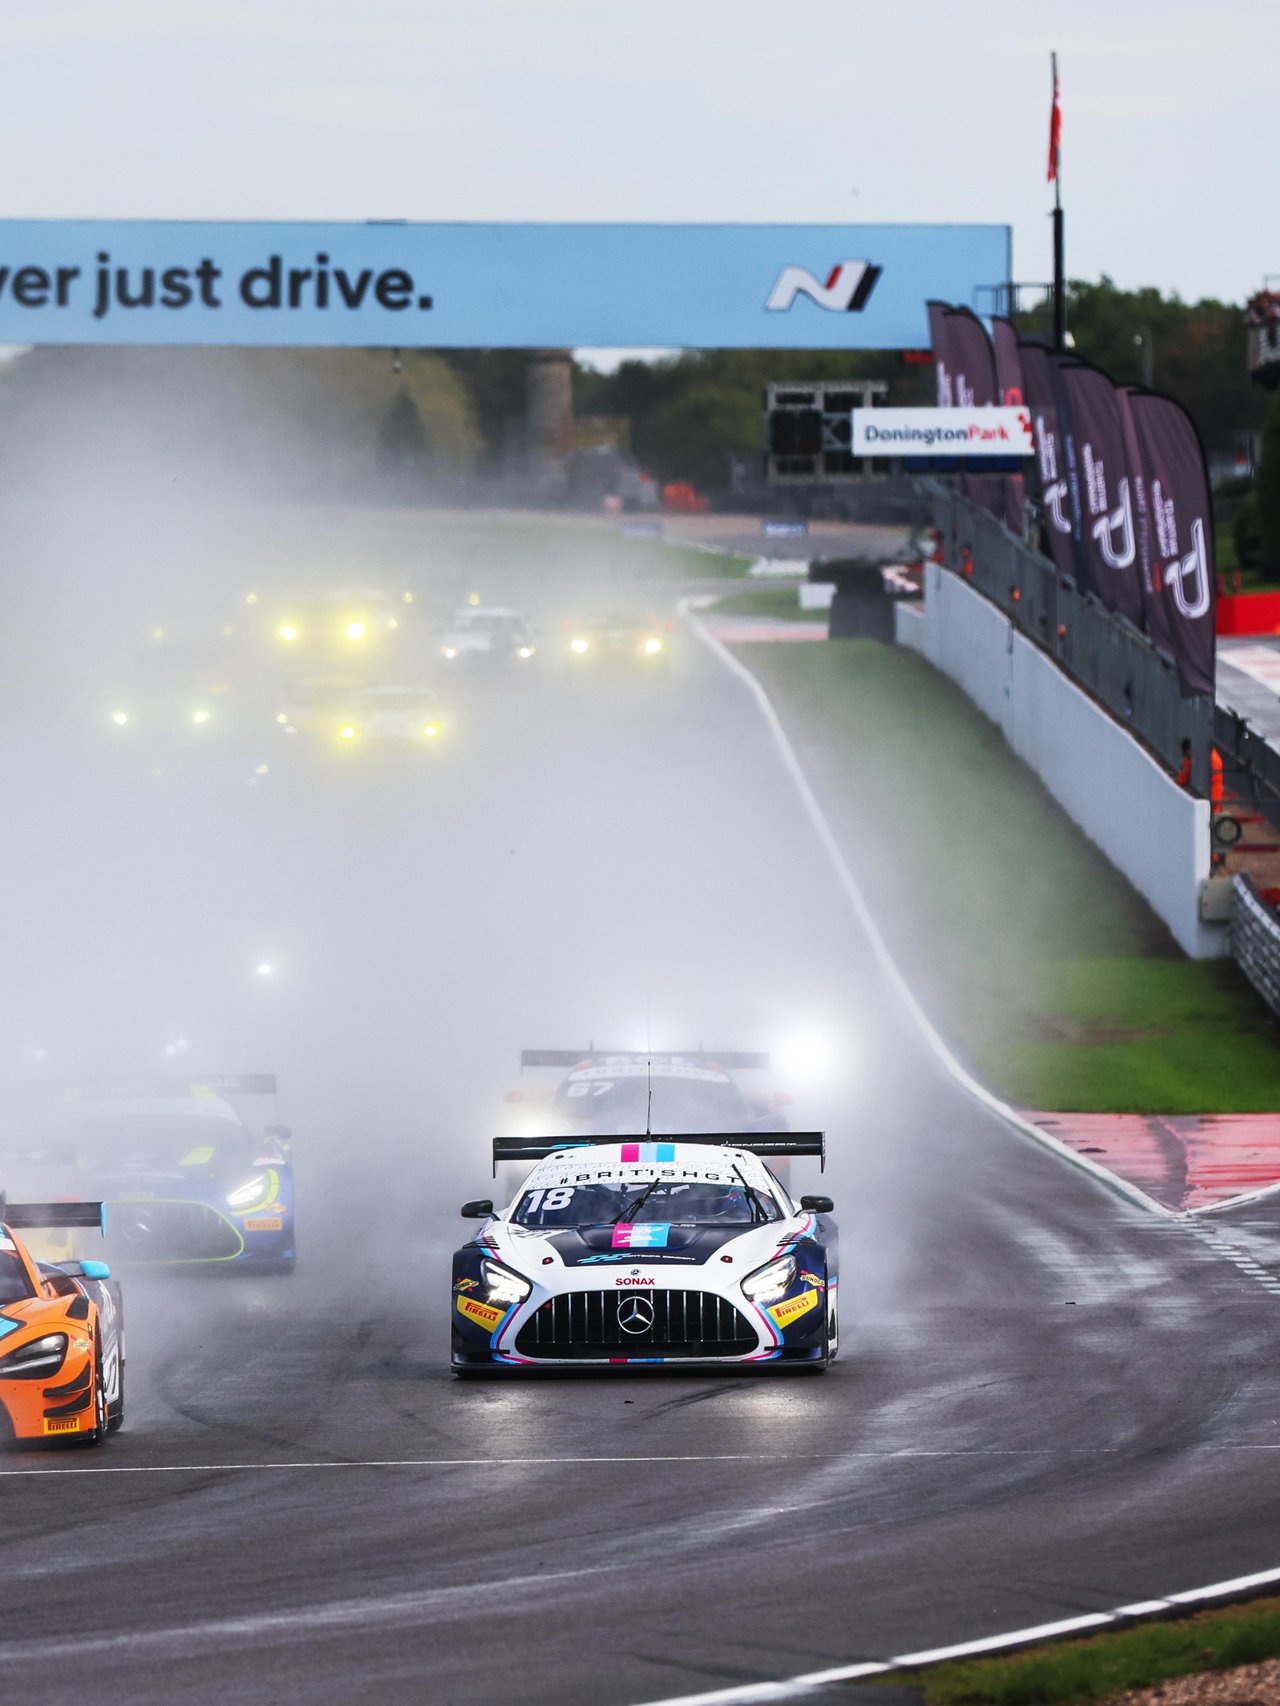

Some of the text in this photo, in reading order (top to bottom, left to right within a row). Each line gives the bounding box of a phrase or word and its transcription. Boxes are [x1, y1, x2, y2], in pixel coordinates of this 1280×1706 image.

[93, 252, 221, 319] just
[238, 255, 433, 310] drive.
[864, 424, 1009, 445] DoningtonPark
[567, 1081, 616, 1097] 67
[560, 1168, 740, 1185] #BRITISHGT
[526, 1188, 576, 1213] 18
[615, 1277, 656, 1286] SONAX
[464, 1301, 499, 1321] PIRELLI
[775, 1297, 810, 1318] PIRELLI
[48, 1417, 78, 1431] PIRELLI
